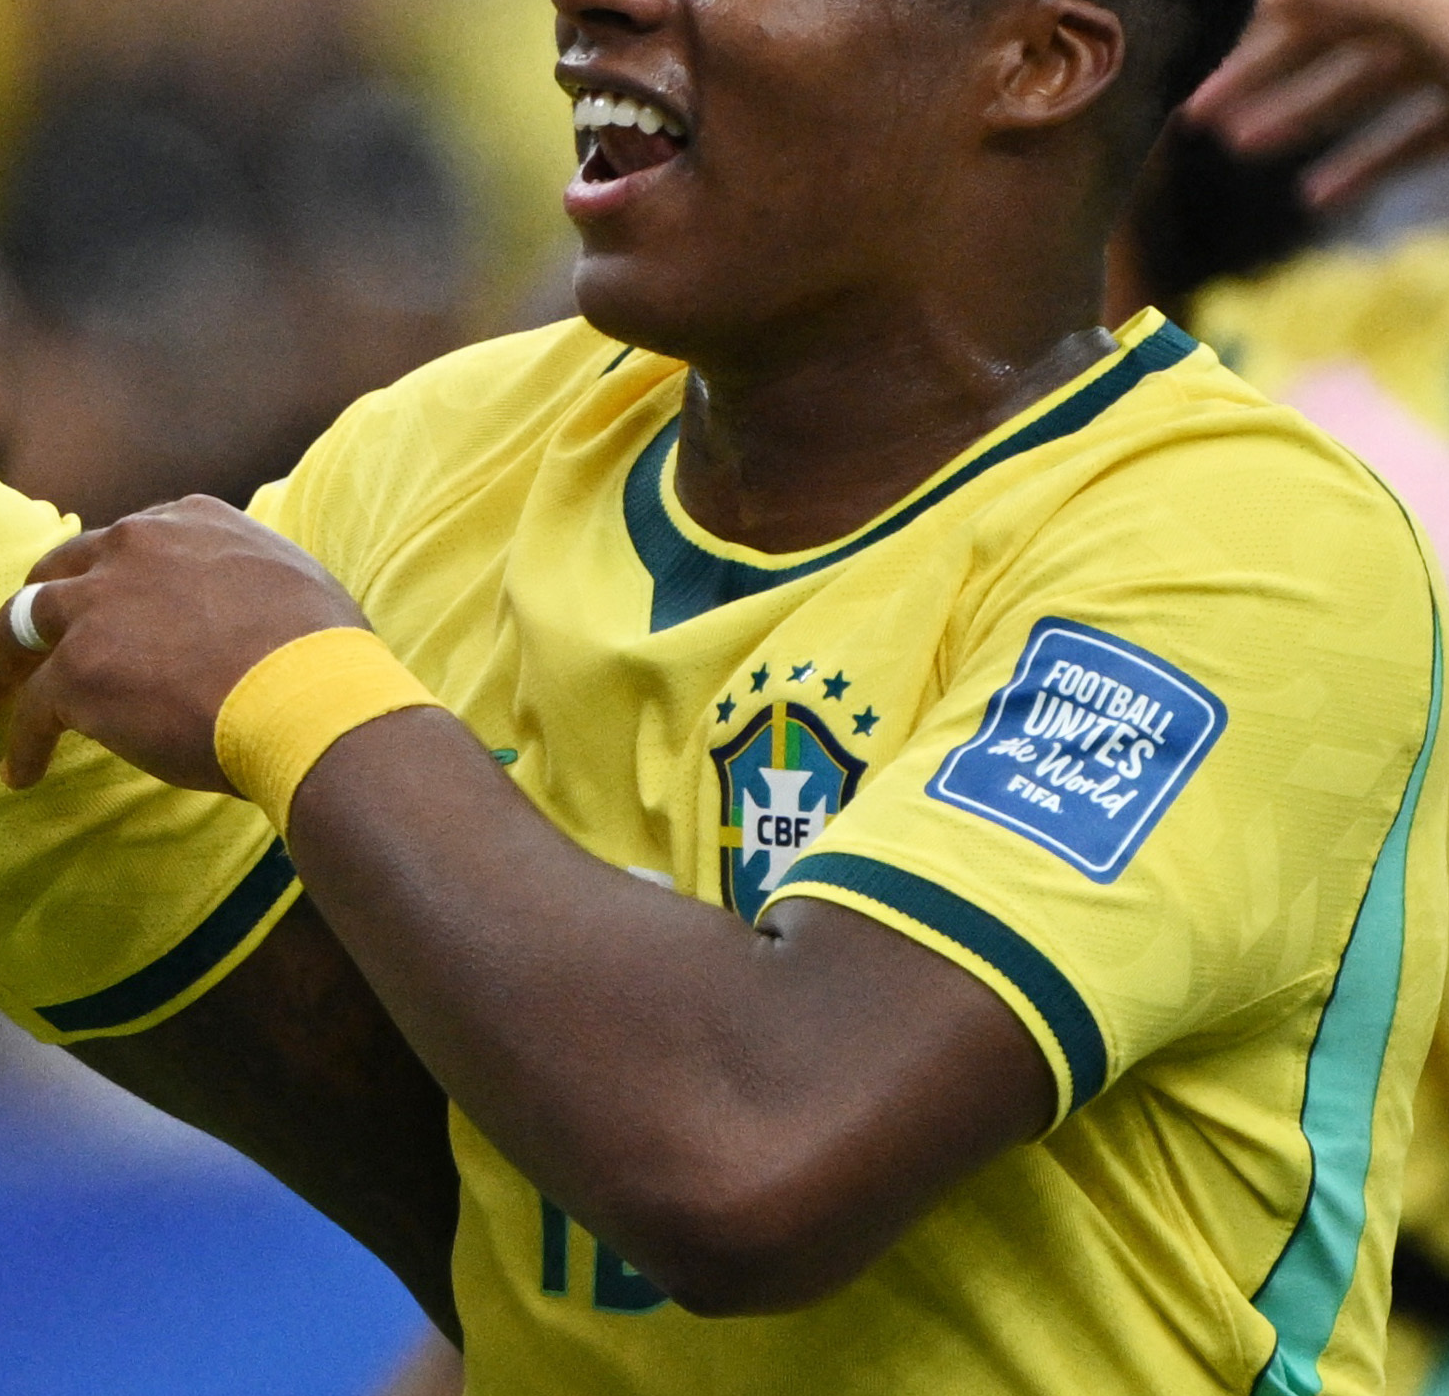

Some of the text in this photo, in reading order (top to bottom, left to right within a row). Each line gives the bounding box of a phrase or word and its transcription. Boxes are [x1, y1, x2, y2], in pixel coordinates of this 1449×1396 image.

[1023, 690, 1155, 780] UNITES
[1042, 659, 1175, 745] FOOTBALL
[988, 736, 1139, 819] the World
[1007, 774, 1062, 813] FIFA
[757, 814, 811, 848] CBF
